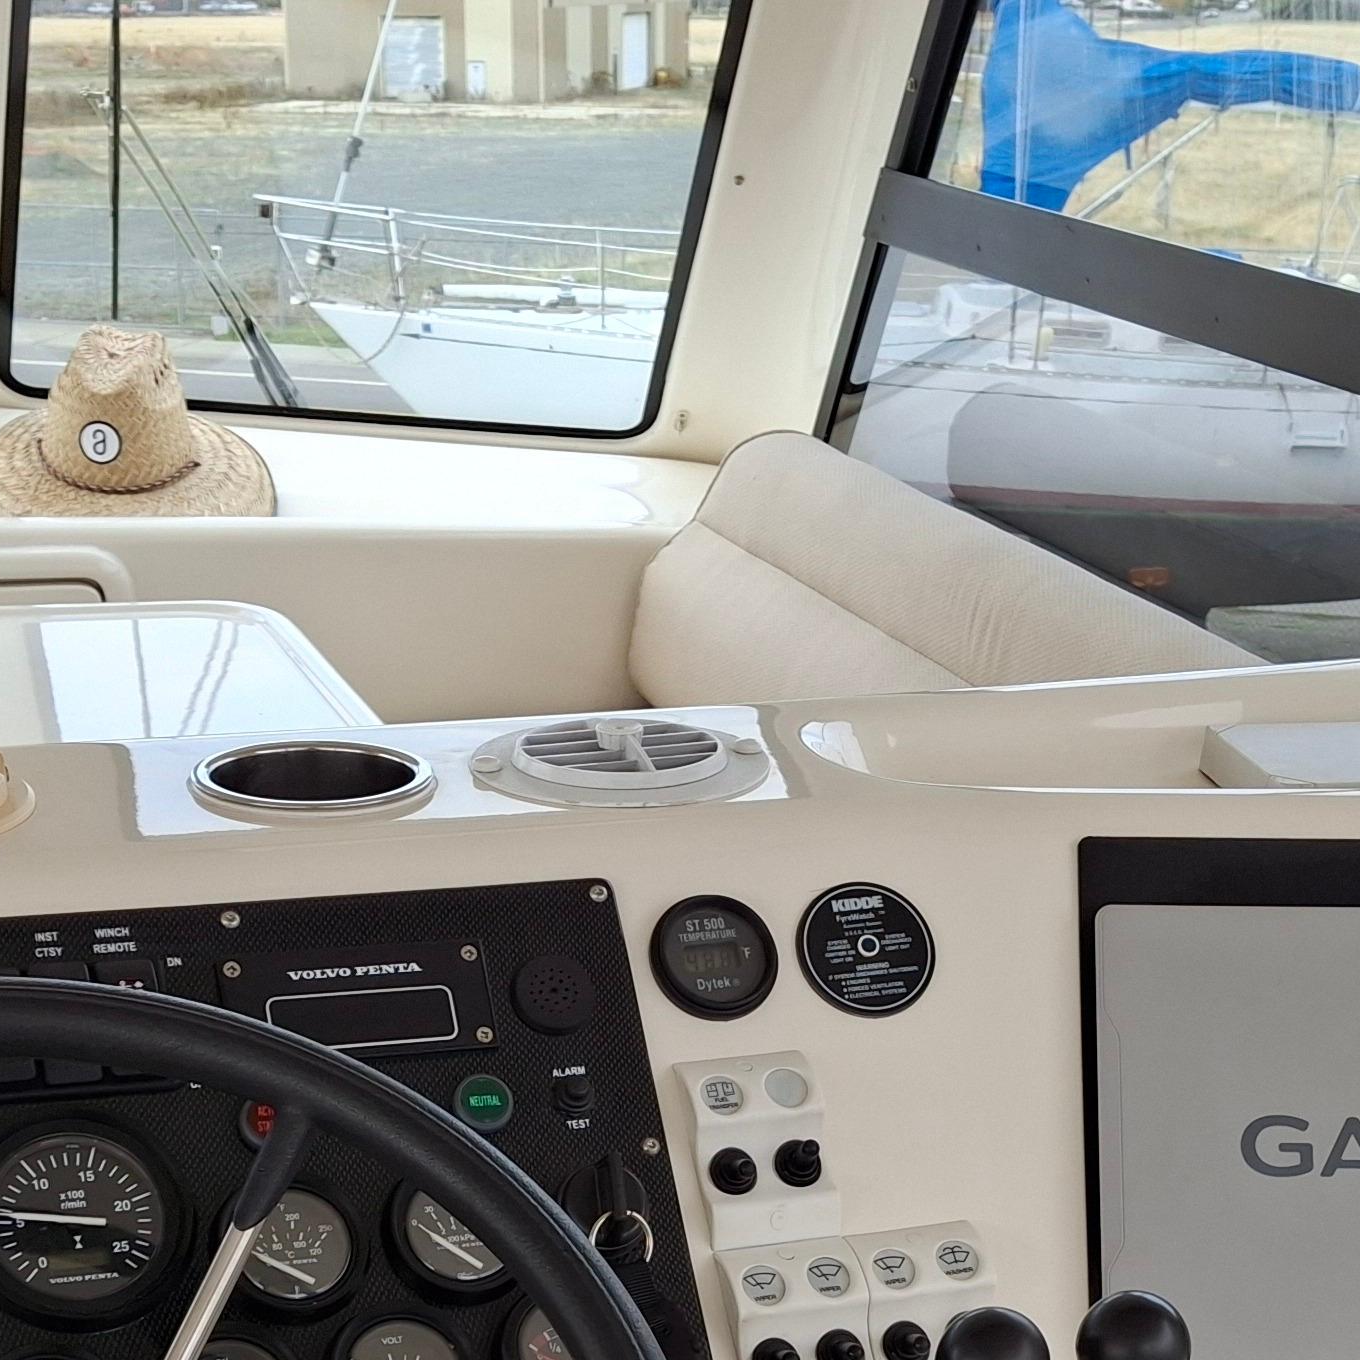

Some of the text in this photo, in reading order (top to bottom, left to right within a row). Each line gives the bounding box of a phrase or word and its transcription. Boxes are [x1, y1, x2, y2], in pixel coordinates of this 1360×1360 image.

[831, 895, 884, 912] KIDDE
[685, 917, 725, 931] ST 500
[34, 931, 58, 943] INST
[94, 927, 130, 939] WINCH
[678, 928, 737, 942] TEMPERATURE
[35, 947, 62, 959] CTSY
[92, 942, 137, 954] REMOTE
[166, 957, 182, 968] DN
[286, 961, 423, 982] VOLVO PENTA
[697, 976, 731, 992] Dytek
[552, 1065, 586, 1078] ALARM
[469, 1094, 502, 1107] NEUTRAL
[566, 1118, 590, 1130] TEST
[78, 1170, 95, 1182] 15
[32, 1178, 49, 1191] 10
[60, 1200, 86, 1210] r/min
[114, 1200, 131, 1212] 20
[285, 1213, 300, 1221] 200
[112, 1241, 130, 1253] 25
[38, 1257, 48, 1268] 0
[49, 1272, 119, 1284] VOLVO PENTA
[884, 1277, 907, 1286] WIPER
[819, 1285, 841, 1293] WIPER
[754, 1294, 777, 1302] WIPER
[381, 1336, 402, 1345] VOLT
